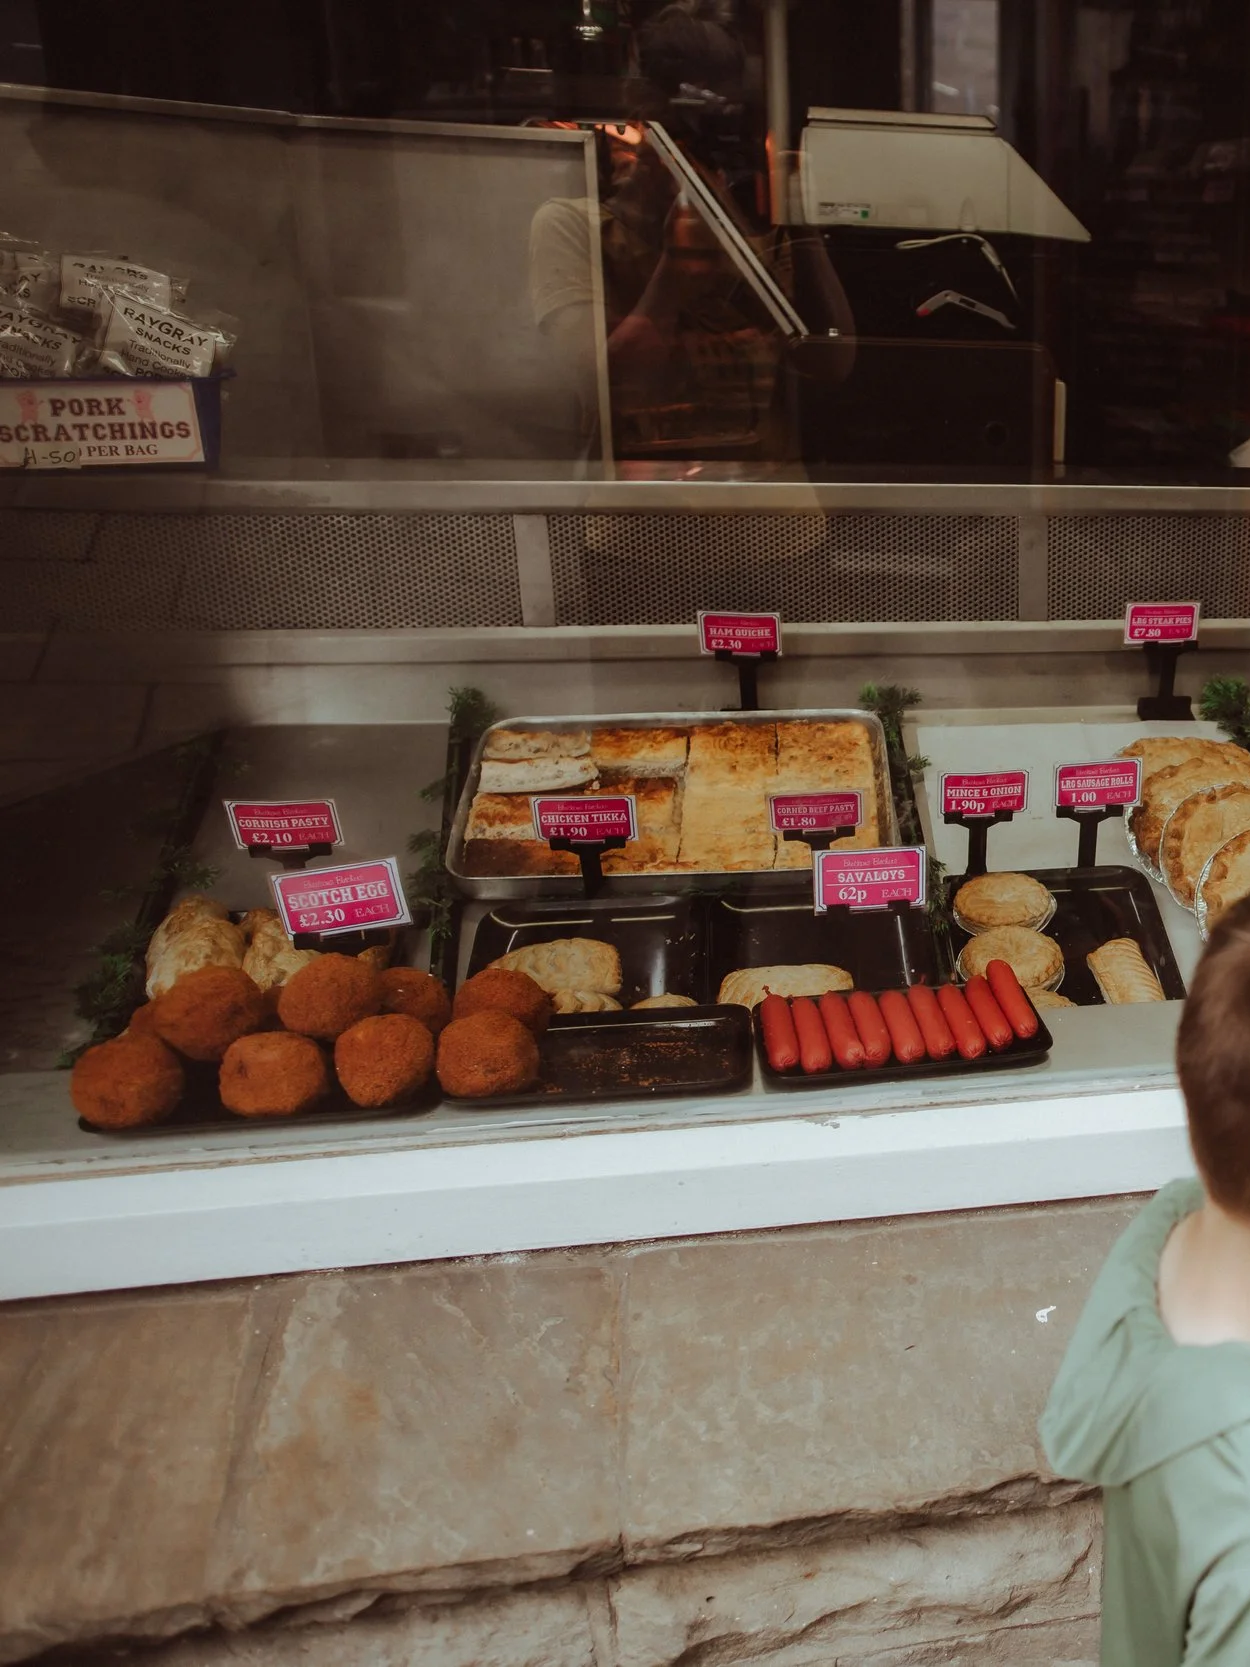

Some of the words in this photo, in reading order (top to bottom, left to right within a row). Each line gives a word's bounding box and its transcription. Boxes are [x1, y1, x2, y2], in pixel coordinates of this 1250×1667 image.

[123, 307, 208, 347] RAYGRAY
[136, 327, 191, 356] SNACKS
[129, 339, 191, 369] Traditionally
[49, 397, 126, 417] PORK
[0, 421, 191, 443] SCRATCHINGS
[87, 445, 120, 457] PER
[125, 444, 158, 456] BAG
[1148, 617, 1175, 625] STEAK
[1175, 616, 1192, 624] PIES
[709, 627, 733, 636] HAM
[735, 628, 771, 637] QUICHE
[1133, 627, 1161, 638] £7.80
[711, 639, 742, 649] £2.30
[1061, 779, 1076, 789] LRG
[1077, 777, 1110, 788] SAUSAGE
[1110, 775, 1134, 786] ROLLS
[946, 788, 981, 797] MINCE
[982, 788, 988, 796] &
[990, 785, 1022, 796] ONION
[1071, 791, 1097, 803] 1.00
[1106, 790, 1131, 800] EACH
[808, 805, 829, 814] BEEF
[829, 803, 855, 813] PASTY
[951, 799, 986, 813] 1.90p
[238, 818, 289, 829] CORNISH
[291, 816, 328, 827] PASTY
[541, 814, 590, 824] CHICKEN
[591, 812, 628, 822] TIKKA
[782, 816, 817, 827] £1.80
[252, 832, 293, 844] £2.10
[299, 832, 331, 841] EACH
[549, 826, 588, 837] £1.90
[837, 869, 906, 883] SAVALOYS
[287, 887, 354, 910] SCOTCH
[356, 882, 388, 900] EGG
[838, 886, 867, 903] 62p
[881, 887, 912, 898] EACH
[299, 908, 346, 928] £2.30
[355, 903, 390, 918] EACH
